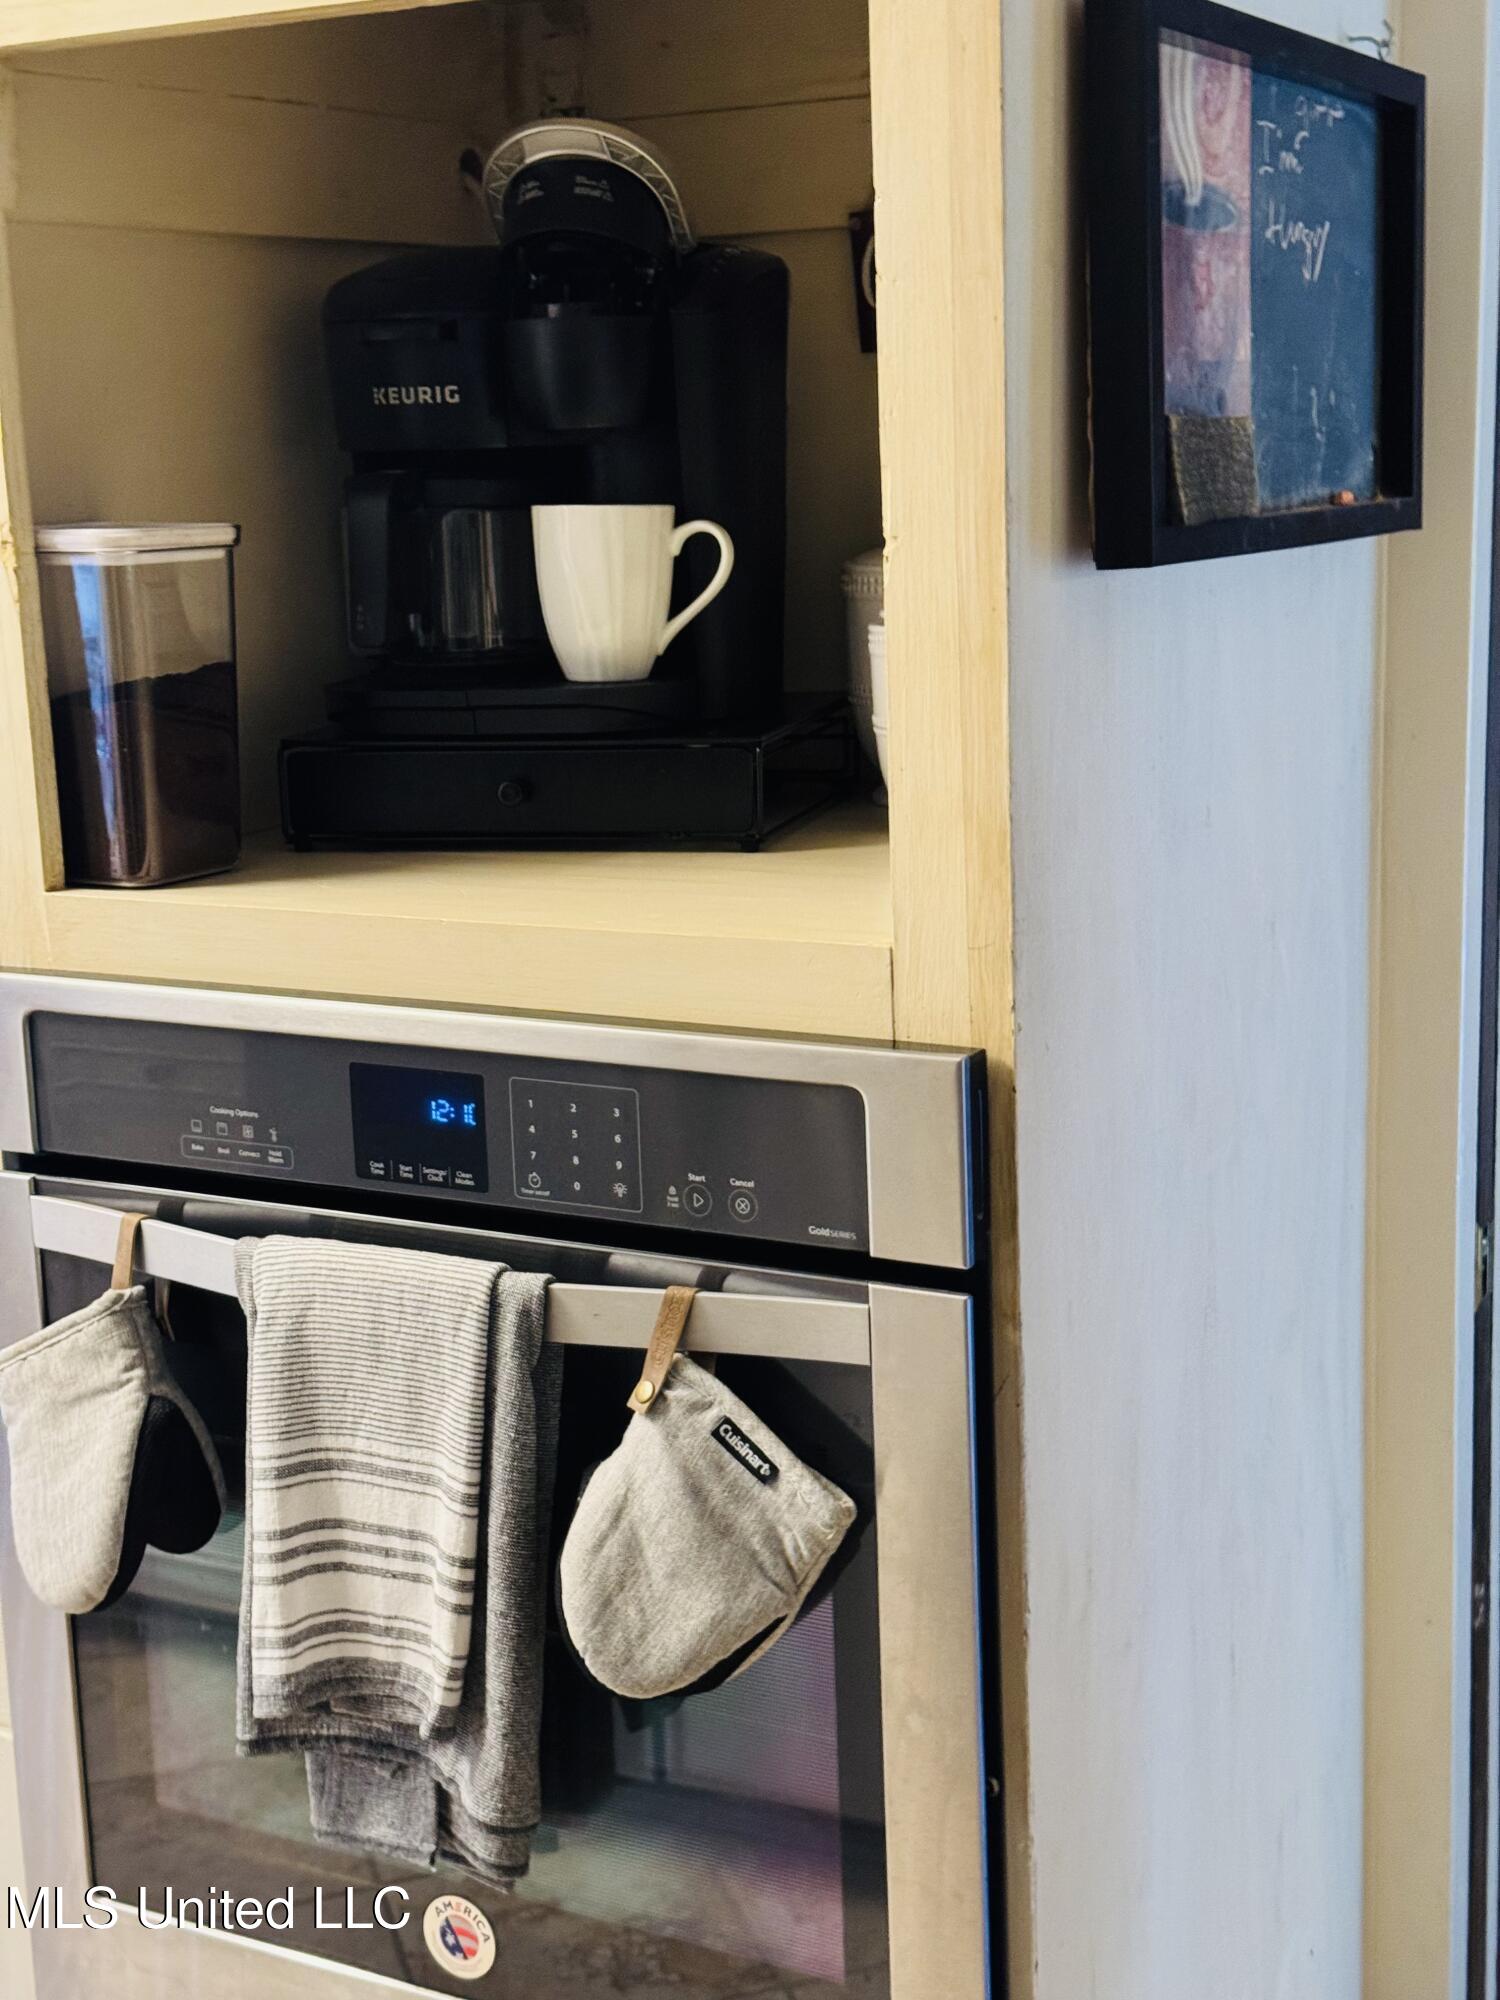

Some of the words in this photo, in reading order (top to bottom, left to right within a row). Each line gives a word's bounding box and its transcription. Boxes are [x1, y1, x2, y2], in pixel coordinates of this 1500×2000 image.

[372, 385, 461, 405] KEURIG
[528, 1099, 533, 1108] 1
[570, 1103, 577, 1112] 2
[613, 1108, 620, 1117] 3
[528, 1125, 535, 1133] 4
[571, 1129, 578, 1138] 5
[614, 1134, 621, 1143] 6
[530, 1150, 536, 1160] 7
[572, 1155, 579, 1165] 8
[615, 1160, 622, 1170] 9
[573, 1181, 581, 1191] 0
[687, 1173, 706, 1183] Start
[729, 1177, 755, 1188] Cancel
[719, 1424, 770, 1476] Cuisinart
[435, 1901, 491, 1944] AMERICA
